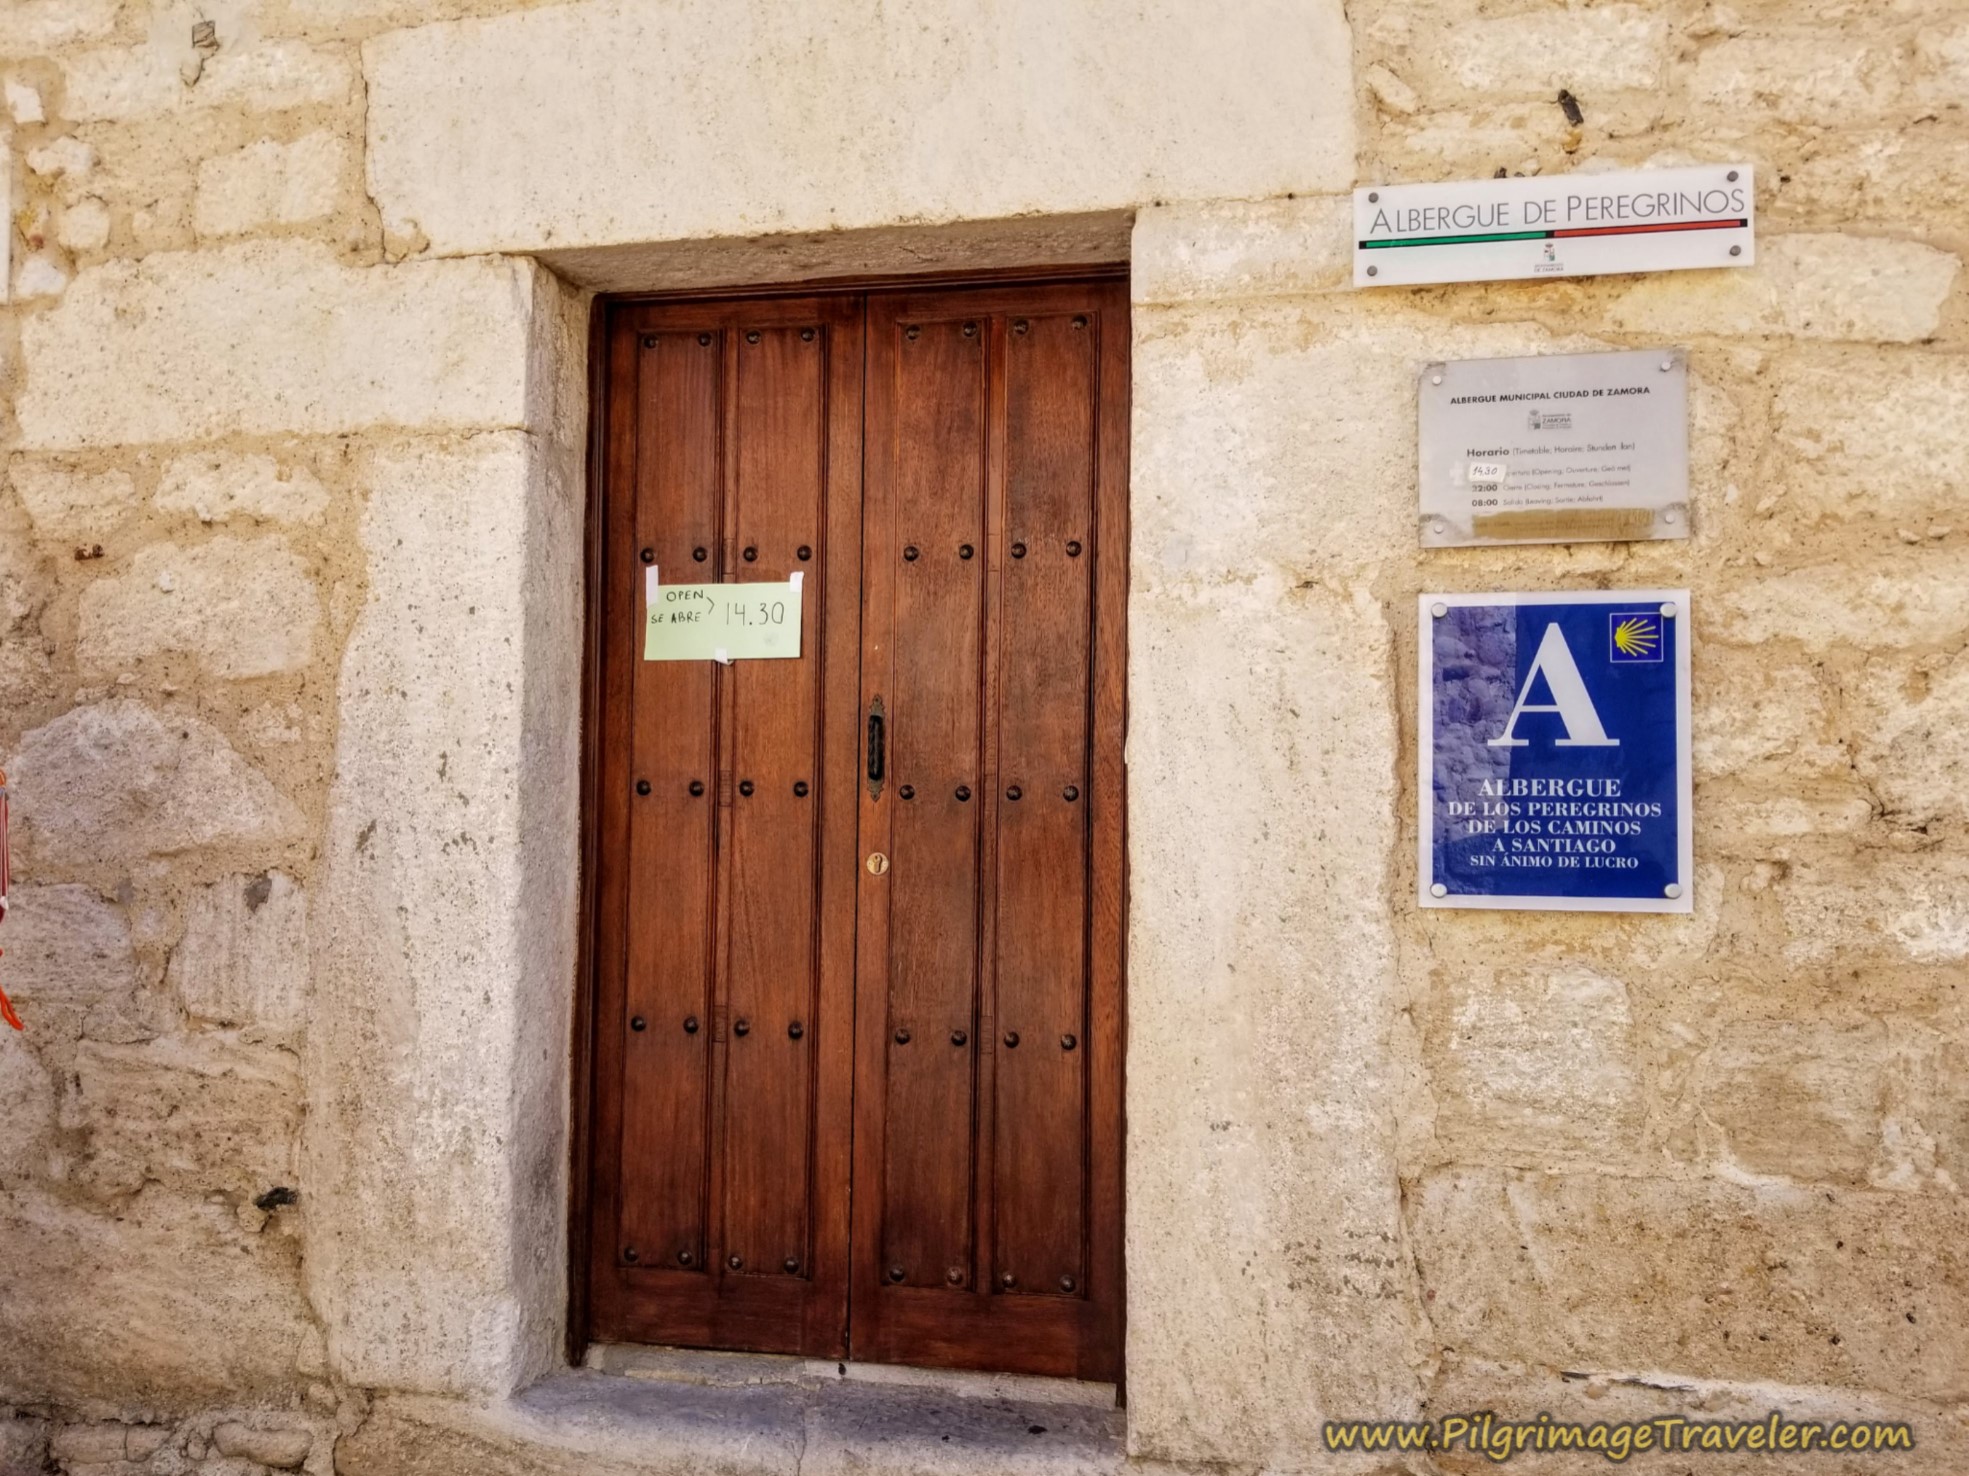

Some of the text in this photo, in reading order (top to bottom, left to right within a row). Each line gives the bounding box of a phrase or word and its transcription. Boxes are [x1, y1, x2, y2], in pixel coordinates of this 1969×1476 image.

[1369, 187, 1745, 234] ALBERGUE DE PEREGRINOS
[1450, 386, 1650, 405] ALBERGUE MUNICIPAL CIUDAD DE ZAMORA
[1467, 446, 1510, 457] Horario
[1472, 484, 1498, 492] 22:00
[1472, 499, 1498, 507] 08:00
[666, 590, 704, 602] OPEN
[651, 611, 701, 624] SE ABRE
[725, 601, 785, 626] 14.30
[1487, 622, 1620, 746] A
[1478, 778, 1621, 797] ALBERGUE
[1448, 801, 1661, 817] DE LOS PEREGRINOS
[1468, 819, 1641, 835] DE LOS CAMINOS
[1492, 838, 1616, 854] A SANTIAGO
[1470, 851, 1639, 869] SIN ÁNIMO DE LUCRO
